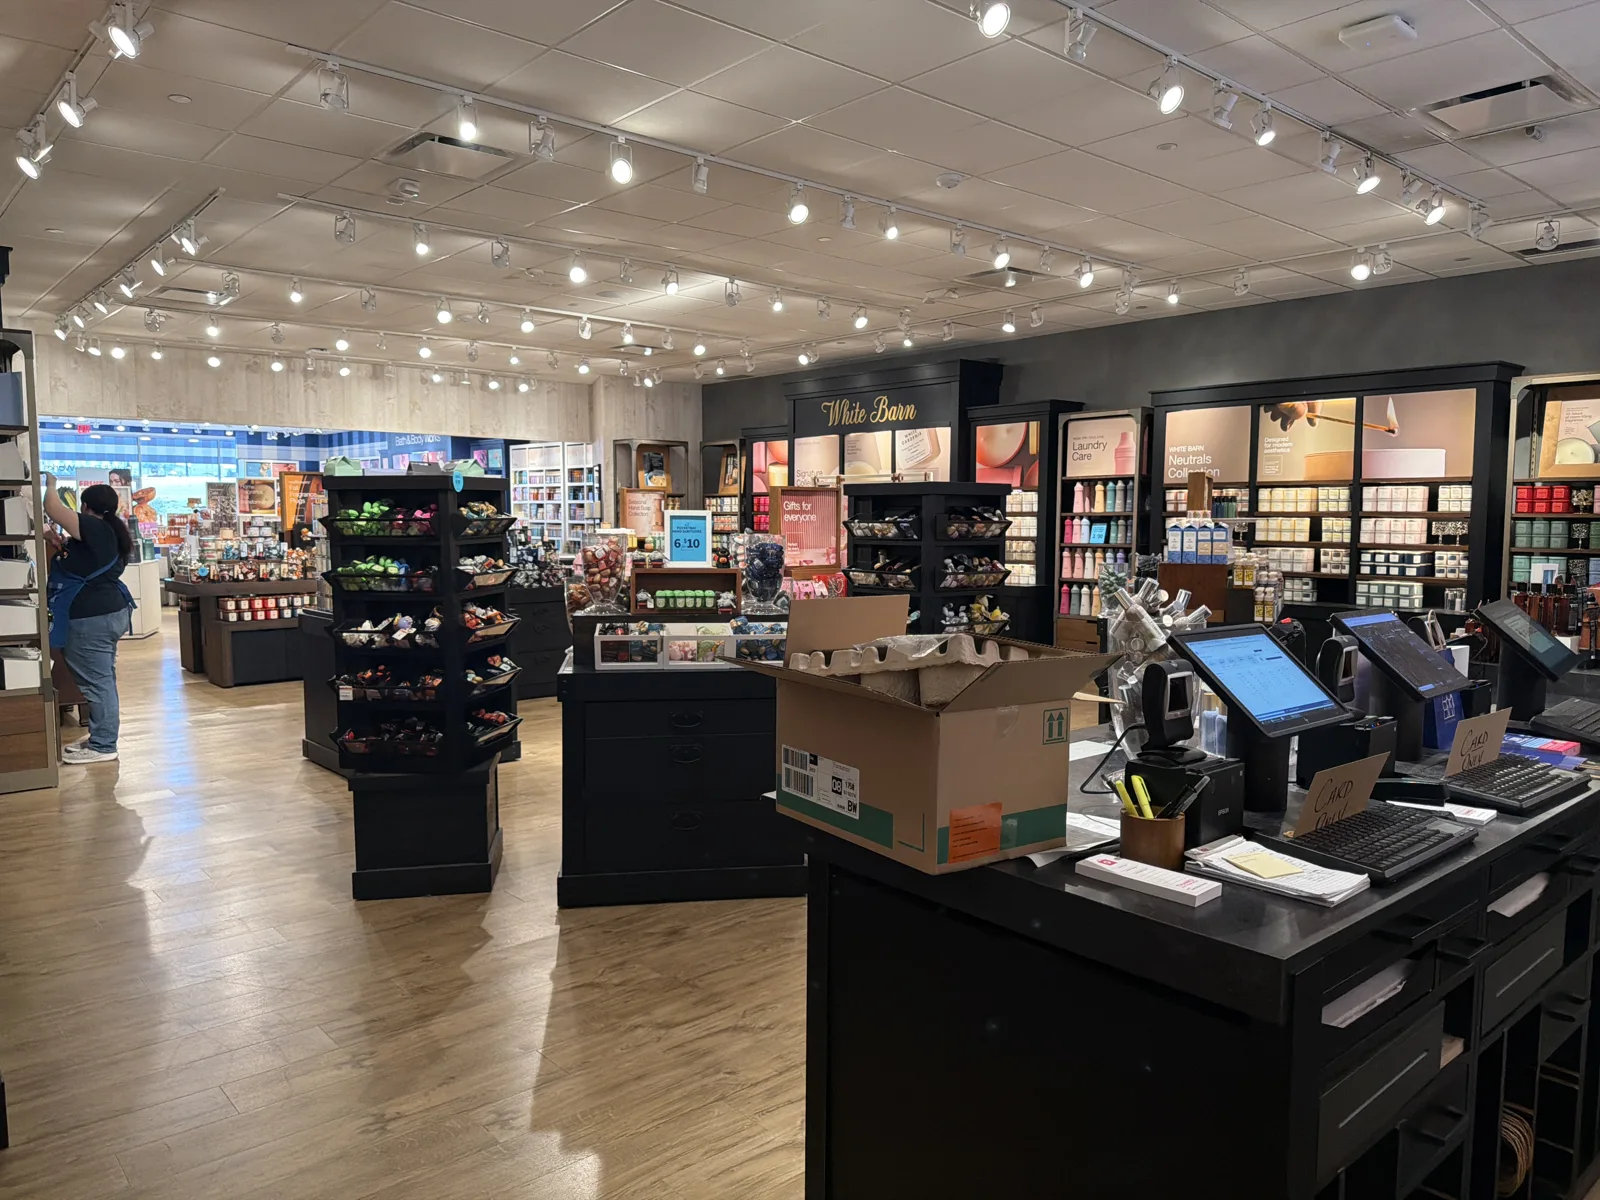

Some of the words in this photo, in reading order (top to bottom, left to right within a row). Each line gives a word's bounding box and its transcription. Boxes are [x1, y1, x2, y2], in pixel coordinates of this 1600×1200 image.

[821, 399, 867, 427] White
[870, 395, 917, 423] Barn
[1264, 436, 1289, 444] Designed
[1072, 440, 1107, 452] Laundry
[1072, 452, 1092, 461] Care
[1169, 454, 1212, 466] Neutrals
[796, 469, 824, 480] Signature
[783, 500, 800, 510] Gifts
[802, 501, 812, 510] for
[784, 514, 816, 523] everyone
[674, 538, 681, 548] 6
[684, 538, 700, 548] $10
[1460, 730, 1489, 757] CARD
[833, 779, 842, 792] 08
[1314, 779, 1353, 813] CARD
[1218, 808, 1230, 816] EPSON
